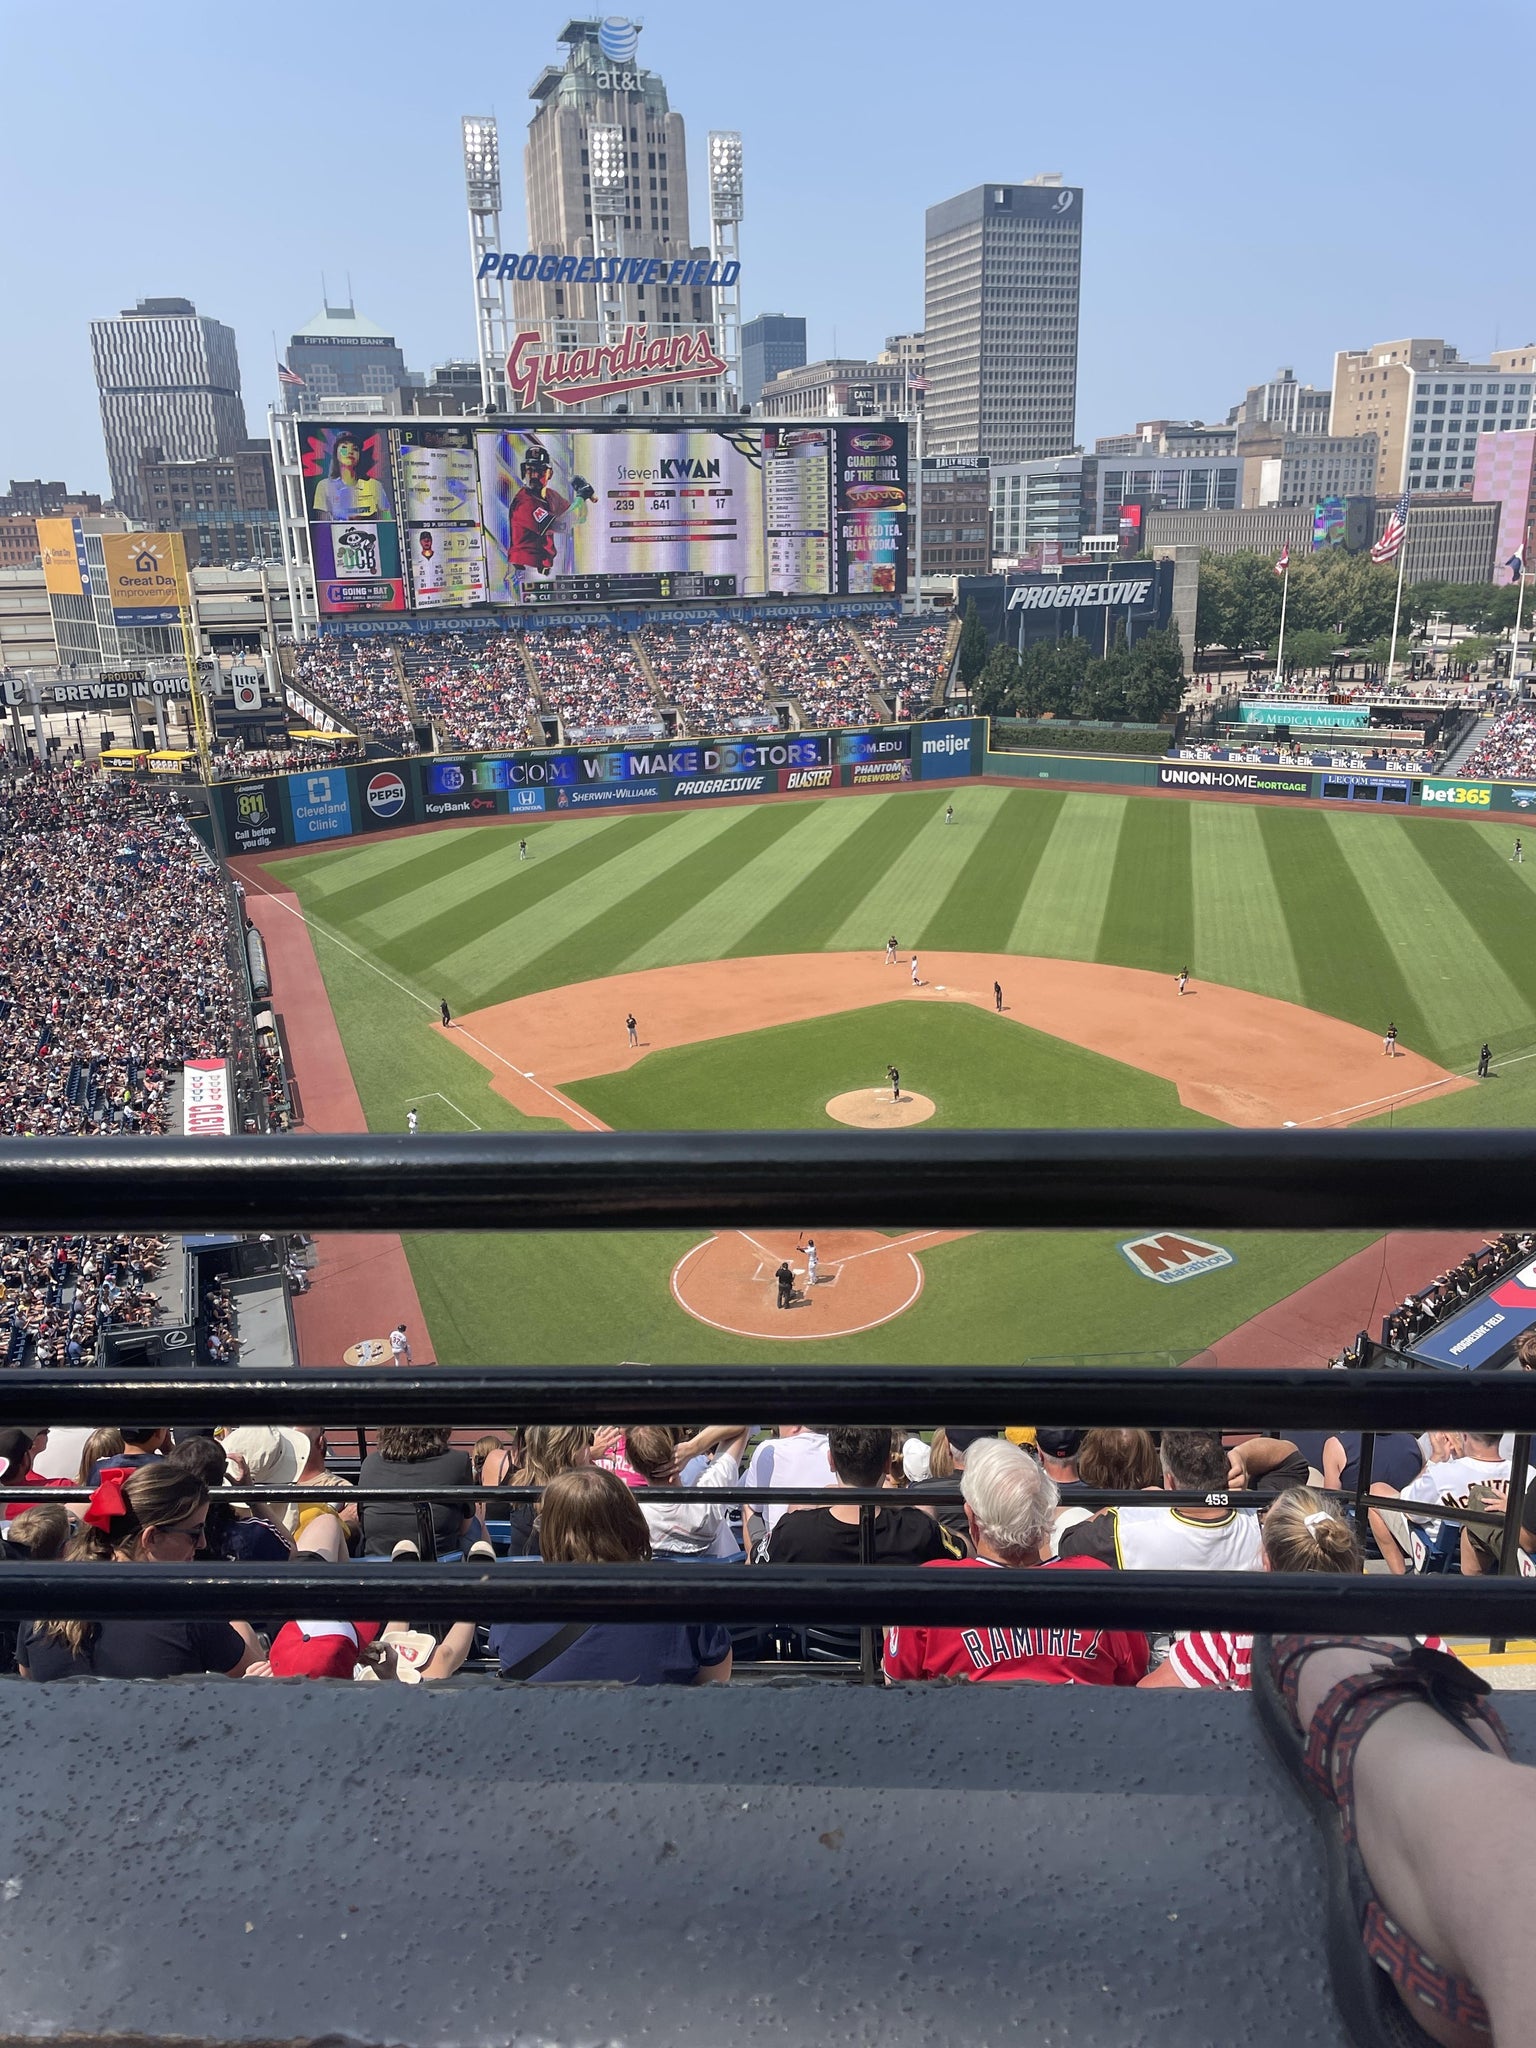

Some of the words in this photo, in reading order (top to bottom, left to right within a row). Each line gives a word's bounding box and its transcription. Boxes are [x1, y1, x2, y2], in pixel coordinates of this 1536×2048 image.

[597, 69, 645, 92] at&t
[477, 252, 661, 285] PROGRESSIVE
[667, 259, 741, 287] FIELD
[304, 336, 329, 345] FIFTH
[330, 336, 359, 345] THIRD
[360, 338, 385, 346] BANK
[506, 323, 729, 409] Guardians
[847, 455, 897, 467] GUARDIANS
[957, 458, 979, 468] HOUSE
[617, 465, 659, 480] Steven
[660, 459, 720, 479] KWAN
[844, 470, 856, 481] OF
[857, 470, 874, 481] THE
[875, 469, 900, 481] GRILL
[613, 500, 635, 511] .239
[650, 500, 670, 510] .641
[716, 499, 725, 509] 17
[843, 526, 864, 537] REAL
[864, 525, 882, 537] ICED
[884, 524, 902, 536] TEA.
[846, 540, 865, 551] REAL
[868, 538, 899, 550] VODKA.
[119, 576, 153, 587] Great
[156, 576, 177, 588] Day
[342, 587, 367, 596] GOING
[1007, 581, 1152, 610] PROGRESSIVE
[765, 606, 822, 616] HONDA
[840, 602, 895, 612] HONDA
[550, 614, 611, 625] HONDA
[661, 609, 720, 621] HONDA
[344, 621, 412, 633] HONDA
[434, 618, 500, 629] HONDA
[100, 671, 146, 682] PROUDLY
[235, 674, 256, 687] Lite
[54, 683, 129, 702] BREWED
[132, 681, 150, 697] IN
[152, 678, 191, 695] OHIO
[1266, 714, 1313, 725] MEDICAL
[922, 735, 971, 755] meijer
[583, 757, 621, 778] WE
[629, 752, 698, 776] MAKE
[704, 743, 822, 770] DOCTORS.
[854, 763, 901, 775] PHANTOM
[787, 770, 832, 789] BLASTER
[853, 773, 900, 784] FIREWORKS
[674, 776, 765, 796] PROGRESSIVE
[1257, 781, 1307, 791] MORTGAGE
[370, 788, 403, 802] PEPSI
[1422, 785, 1491, 805] bet365
[240, 795, 264, 815] 811
[297, 801, 347, 819] Cleveland
[426, 801, 470, 814] KeyBank
[309, 818, 338, 832] Clinic
[235, 830, 250, 840] Call
[252, 827, 276, 838] before
[242, 840, 256, 850] you
[257, 837, 272, 847] dig.
[1158, 1255, 1227, 1281] Marathon
[1449, 1323, 1490, 1356] PROGRESSIVE
[1484, 1313, 1506, 1334] FIELD
[1205, 1494, 1229, 1506] 453
[961, 1627, 1103, 1669] RAMIREZ
